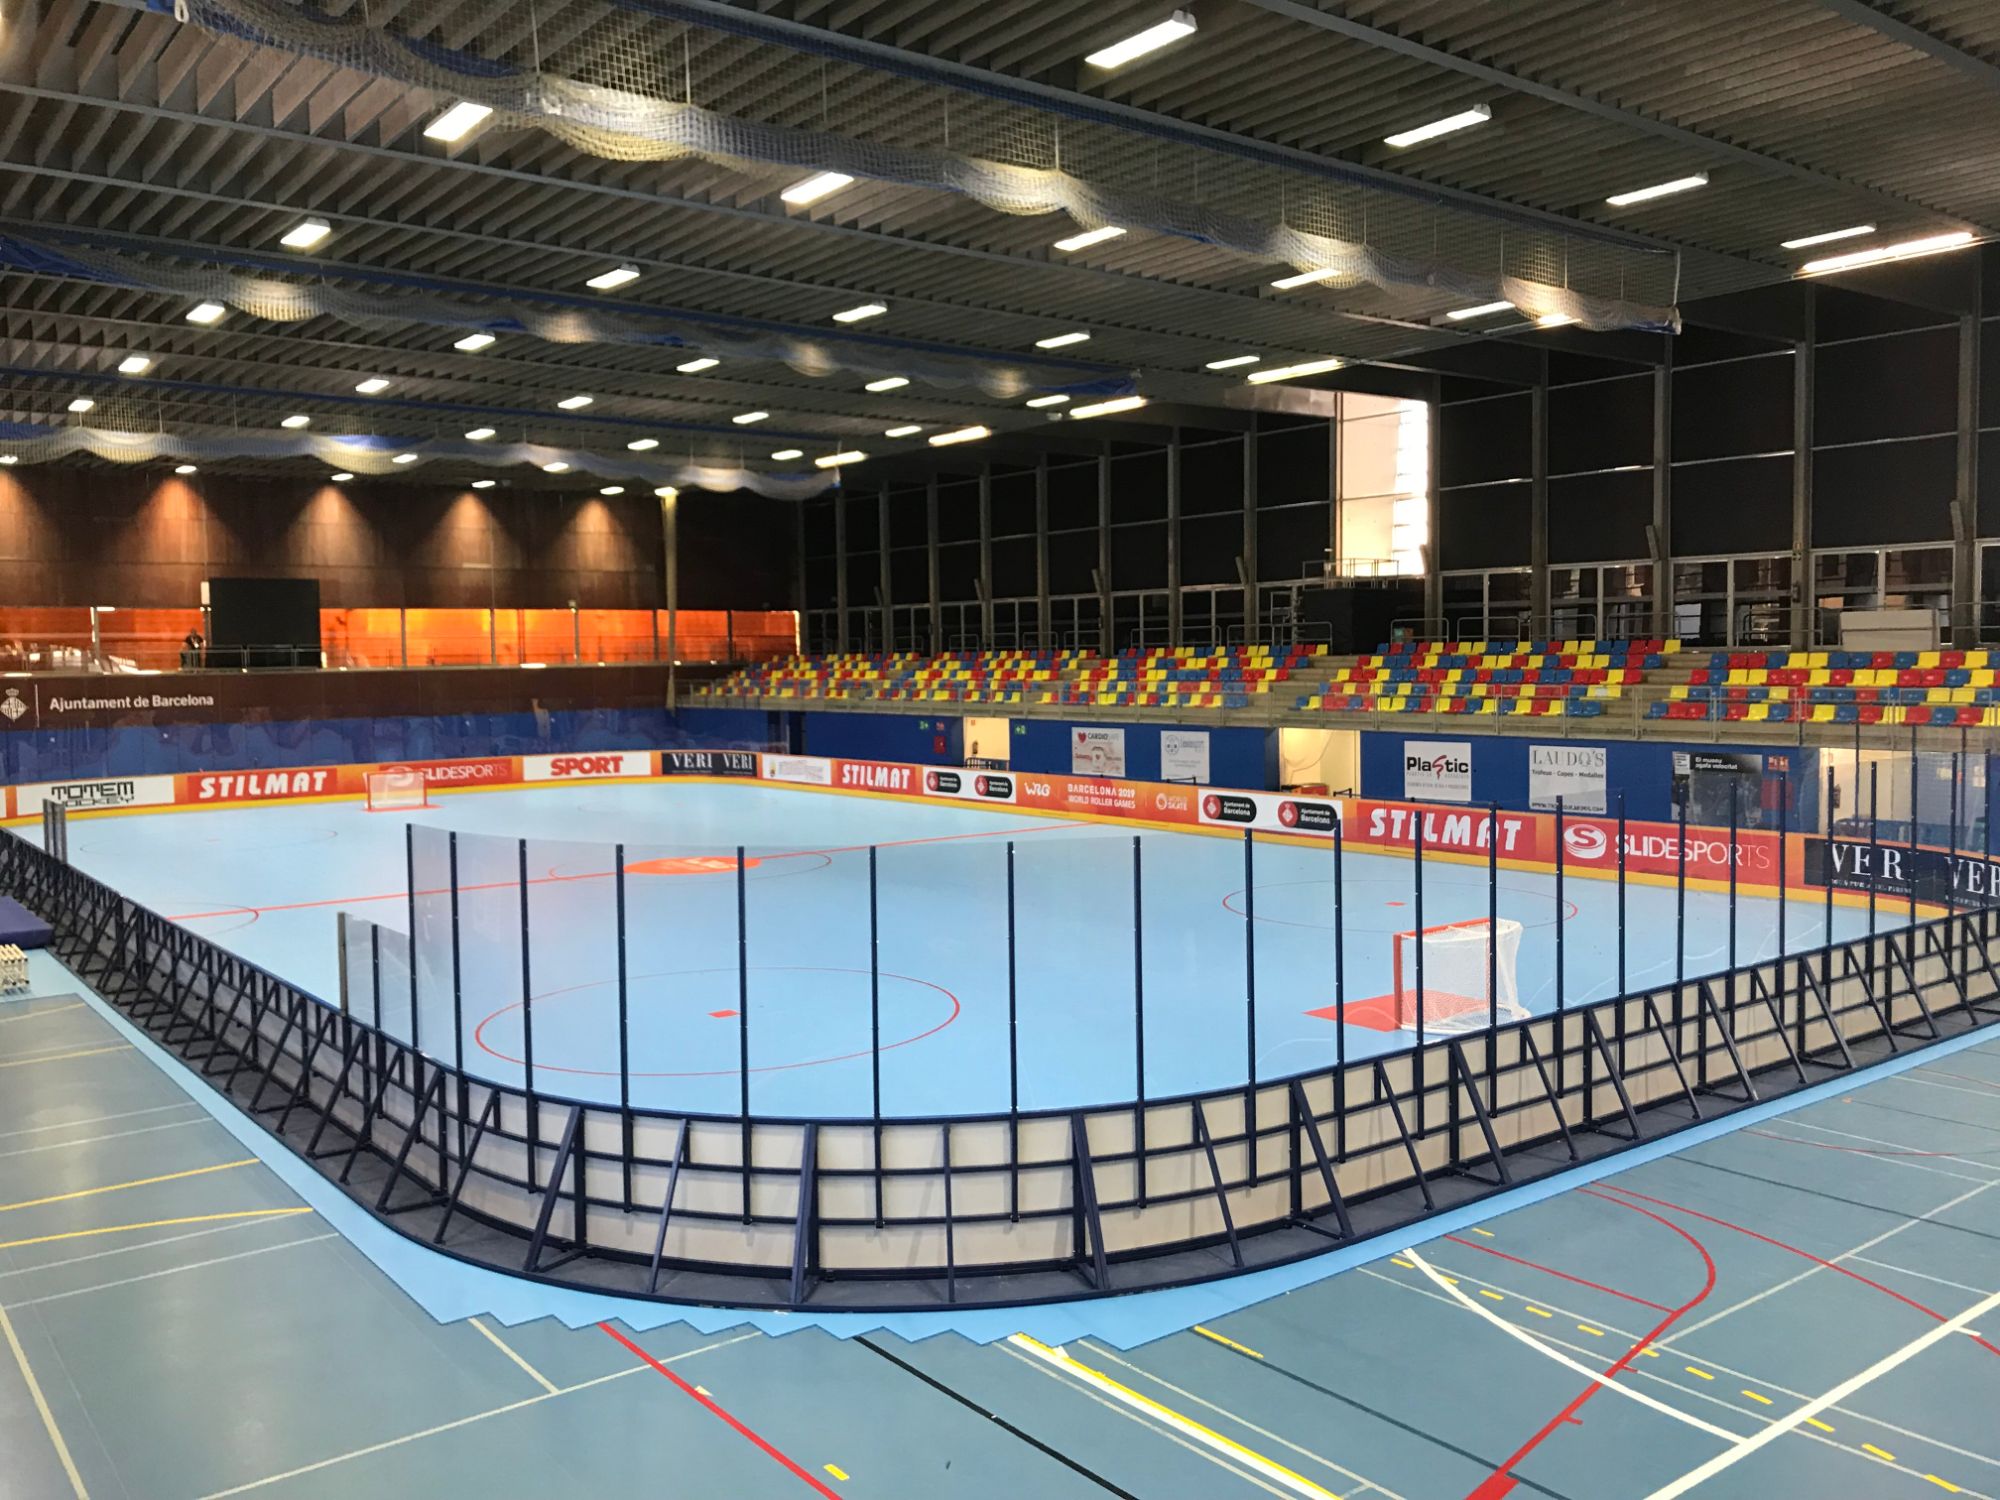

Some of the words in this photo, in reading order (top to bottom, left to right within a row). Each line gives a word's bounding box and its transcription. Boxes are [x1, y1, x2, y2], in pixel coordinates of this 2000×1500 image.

[50, 696, 130, 713] Ajuntament
[134, 696, 150, 708] de
[152, 694, 214, 708] Barcelona
[550, 755, 624, 776] SPORT
[672, 752, 713, 768] VERI
[723, 752, 753, 769] VERI
[199, 771, 328, 799] STILMAT
[842, 763, 911, 789] STILMAT
[51, 781, 134, 800] TOTEM
[1067, 783, 1117, 797] BARCELONA
[1113, 799, 1136, 809] GAMES
[1223, 807, 1251, 816] Barcelona
[1301, 815, 1331, 824] Barcelona
[1369, 808, 1522, 851] STILMAT
[1615, 833, 1771, 869] SLIDESPORTS
[1825, 843, 1920, 883] VER
